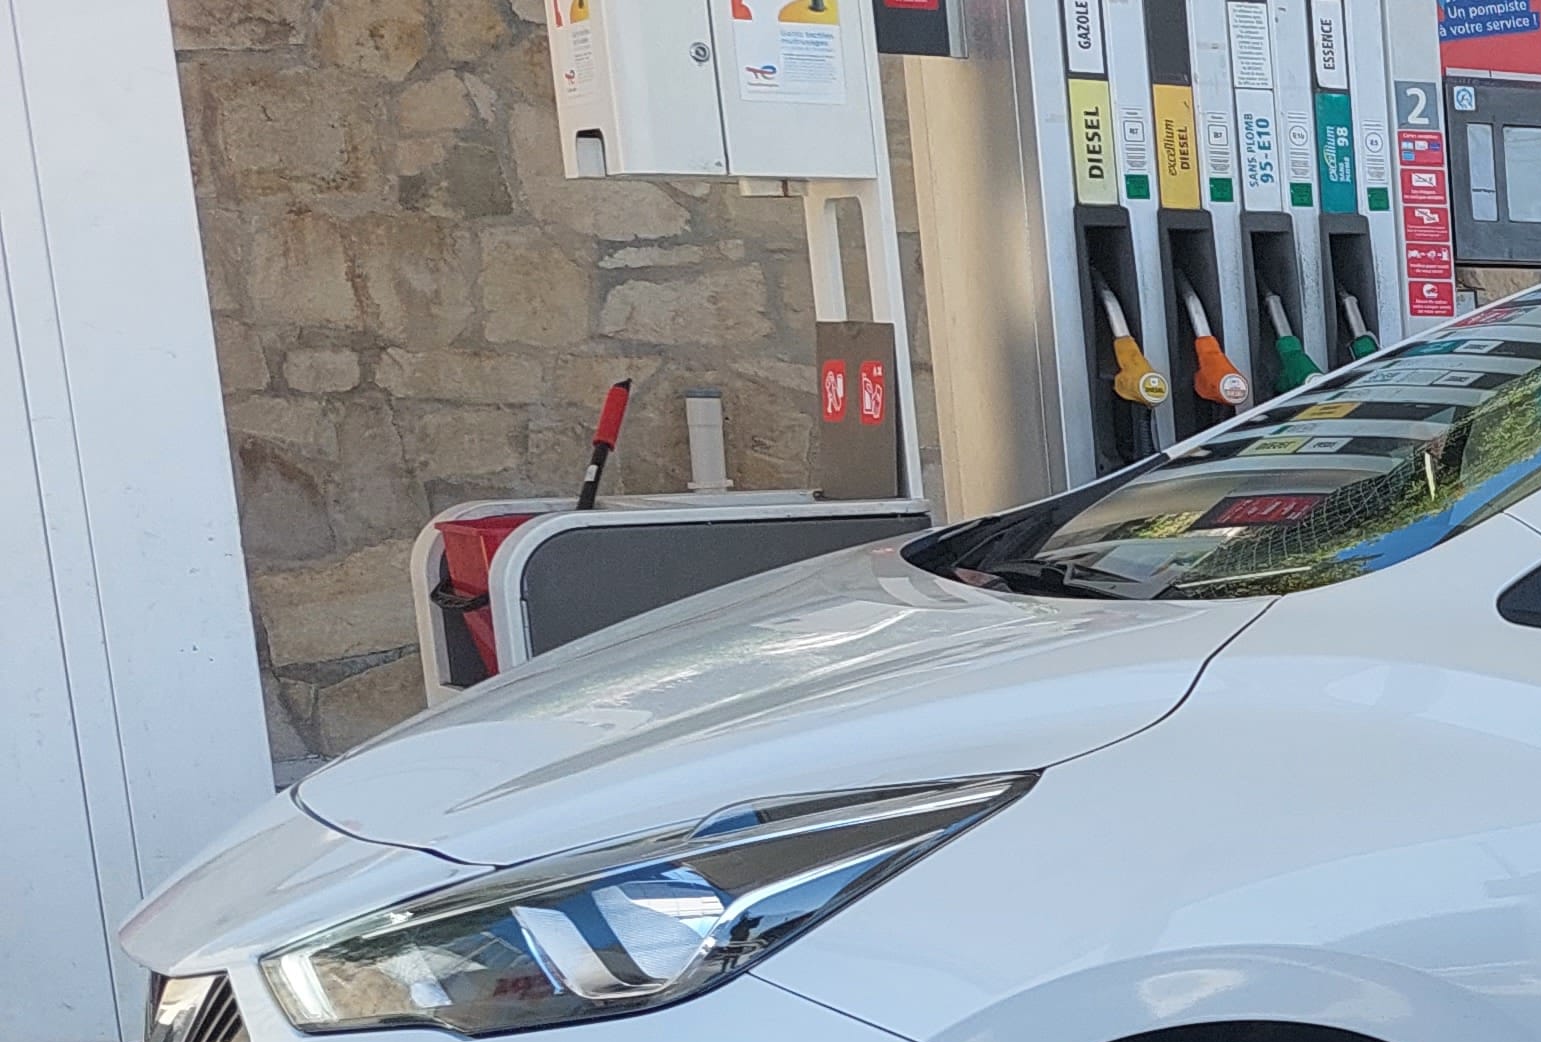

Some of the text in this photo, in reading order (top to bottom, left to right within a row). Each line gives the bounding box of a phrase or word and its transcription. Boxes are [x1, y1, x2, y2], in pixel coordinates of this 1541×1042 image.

[1075, 0, 1092, 50] GAZOLE
[1438, 24, 1447, 37] à
[1450, 22, 1484, 36] votre
[1486, 16, 1531, 32] service
[1447, 0, 1528, 20] Un pompiste
[1319, 17, 1336, 70] ESSENCE
[1405, 87, 1430, 125] 2
[1083, 106, 1105, 179] DIESEL
[1163, 119, 1178, 177] excellium
[1177, 126, 1191, 170] DIESEL
[1243, 113, 1259, 188] SANS PLOMB
[1255, 117, 1275, 184] 95-E10
[1323, 125, 1338, 182] excellium
[1337, 126, 1349, 147] 98
